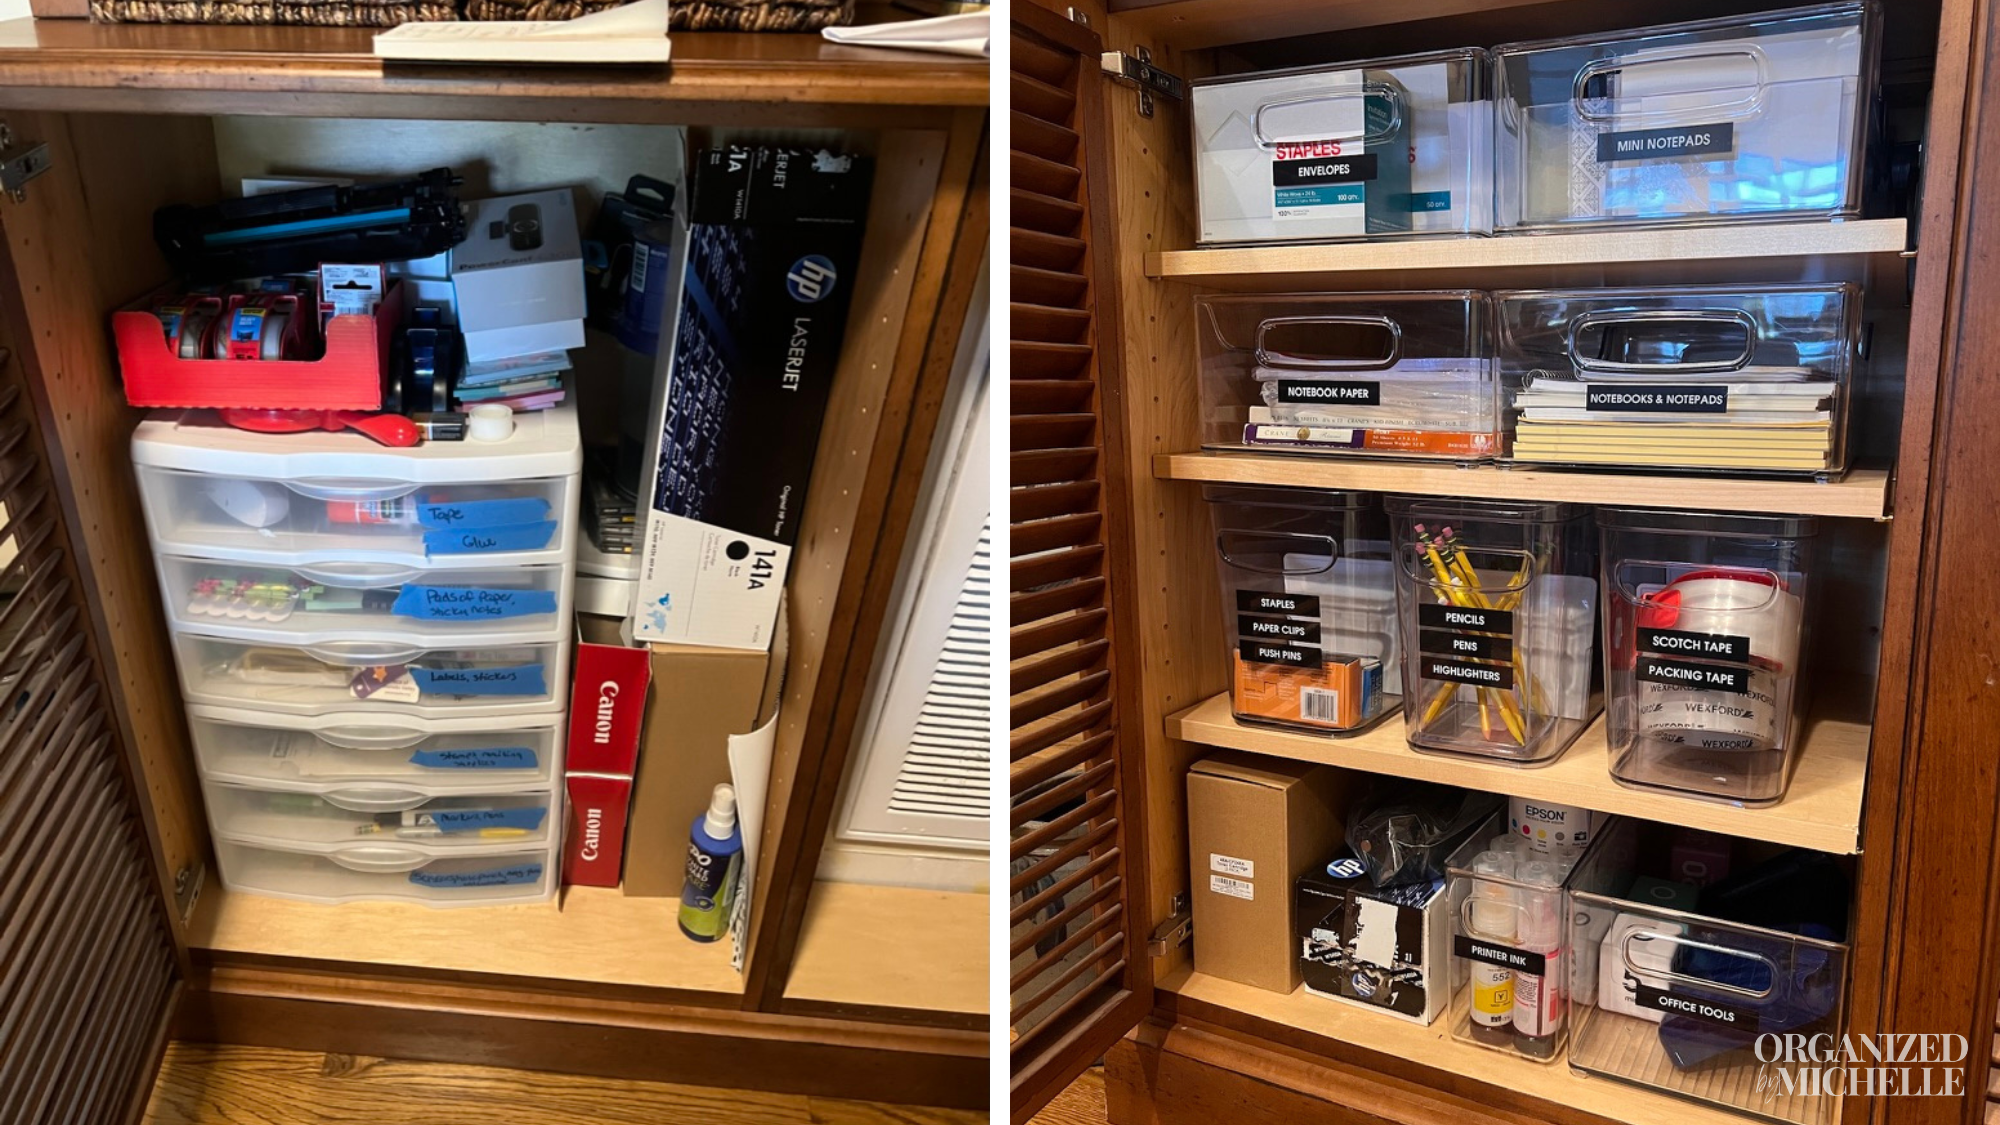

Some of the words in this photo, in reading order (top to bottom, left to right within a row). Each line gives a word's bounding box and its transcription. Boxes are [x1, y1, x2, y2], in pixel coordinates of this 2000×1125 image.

[1276, 140, 1341, 159] STAPLES
[1617, 138, 1644, 152] MINI
[1646, 133, 1711, 150] NOTEPADS
[1298, 164, 1350, 177] ENVELOPES
[787, 256, 837, 301] hp
[782, 318, 811, 391] LASERJET
[1288, 386, 1338, 398] NOTEBOOK
[1340, 388, 1369, 399] PAPER
[1590, 392, 1653, 405] NOTEBOOKS
[1655, 394, 1664, 405] &
[1666, 394, 1723, 406] NOTEPADS
[428, 507, 464, 524] Tape
[462, 535, 496, 549] Glue
[747, 550, 777, 590] 141A
[1261, 598, 1295, 610] STAPLES
[1445, 612, 1485, 626] PENCILS
[1253, 622, 1279, 633] PAPER
[1282, 625, 1305, 636] CLIPS
[1453, 640, 1478, 652] PENS
[1652, 635, 1701, 651] SCOTCH
[1704, 640, 1732, 654] TAPE
[1259, 648, 1280, 658] PUSH
[1282, 650, 1302, 661] PINS
[1433, 664, 1500, 682] HIGHLIGHTERS
[1648, 665, 1703, 681] PACKING
[1705, 671, 1734, 685] TAPE
[593, 681, 619, 744] Canon
[1685, 703, 1741, 717] WEXFORD
[1702, 740, 1746, 748] WEXFORD
[1526, 805, 1564, 821] EPSON
[581, 808, 602, 861] Canon
[1327, 859, 1366, 878] hp
[1472, 945, 1507, 962] PRINTER
[1510, 954, 1526, 966] INK
[1493, 972, 1510, 981] 552
[1659, 996, 1696, 1013] OFFICE
[1699, 1004, 1735, 1022] TOOLS
